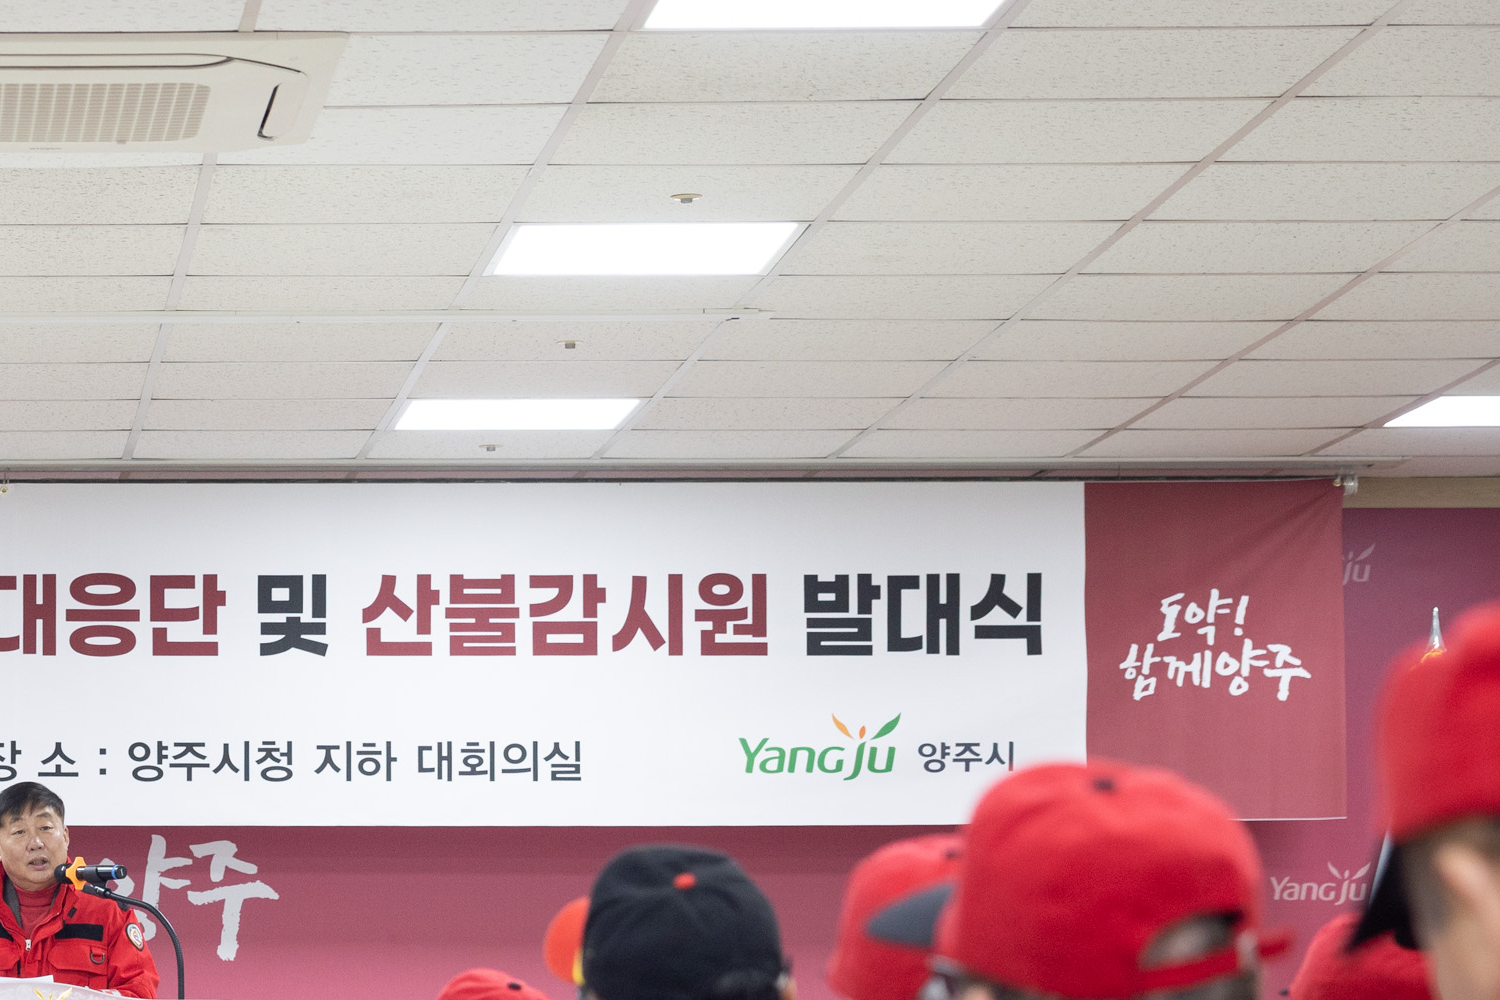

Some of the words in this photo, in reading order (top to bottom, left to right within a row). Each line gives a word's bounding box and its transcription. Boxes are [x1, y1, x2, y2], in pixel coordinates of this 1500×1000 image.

[257, 573, 329, 657] 및
[362, 573, 769, 657] 산불감시원
[803, 573, 1043, 657] 발대식
[1156, 588, 1250, 646] 도약!
[128, 740, 293, 783] 양주시청
[314, 740, 398, 782] 지하
[417, 740, 582, 782] 대회의실
[917, 741, 1016, 773] 양주시
